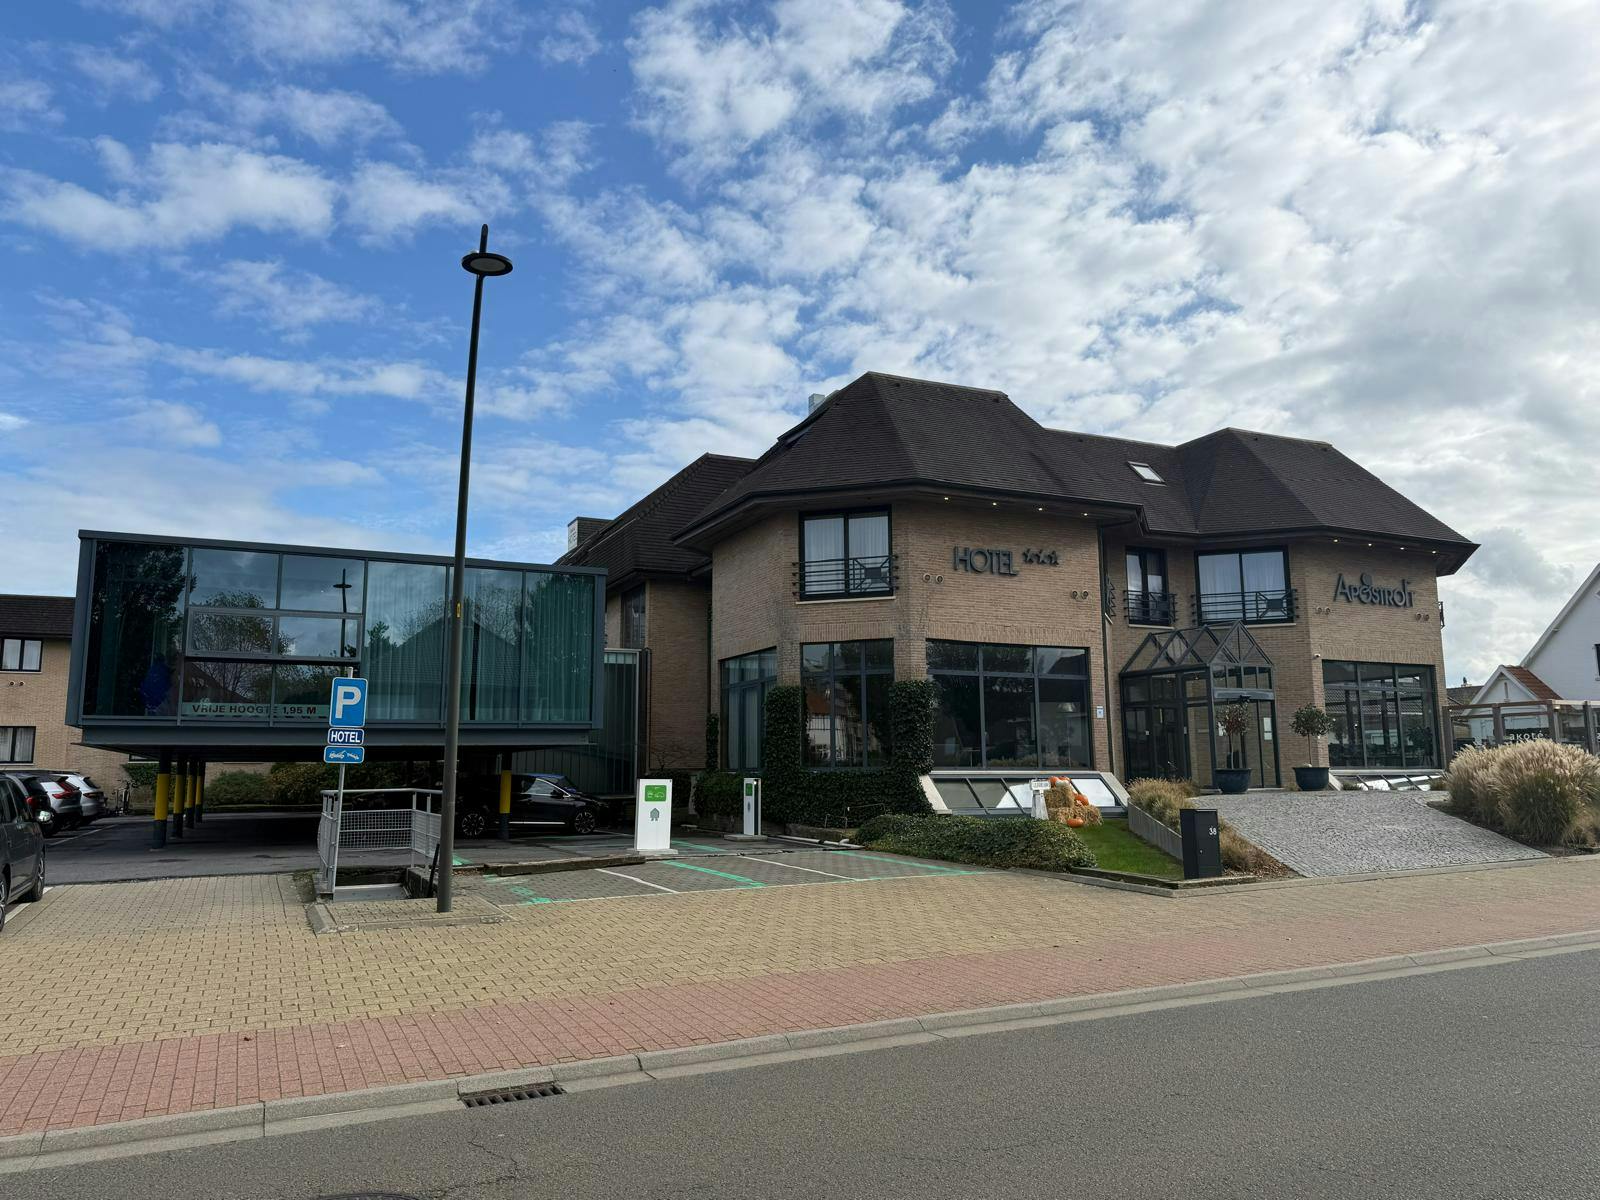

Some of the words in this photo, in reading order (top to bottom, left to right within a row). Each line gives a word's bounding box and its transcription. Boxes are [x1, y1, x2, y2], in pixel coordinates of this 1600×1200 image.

[954, 546, 1018, 575] HOTEL
[335, 686, 361, 719] P
[192, 704, 226, 713] VRIJE
[283, 706, 304, 715] 1,95
[307, 706, 317, 715] M
[330, 731, 361, 743] HOTEL
[1208, 827, 1217, 835] 38
